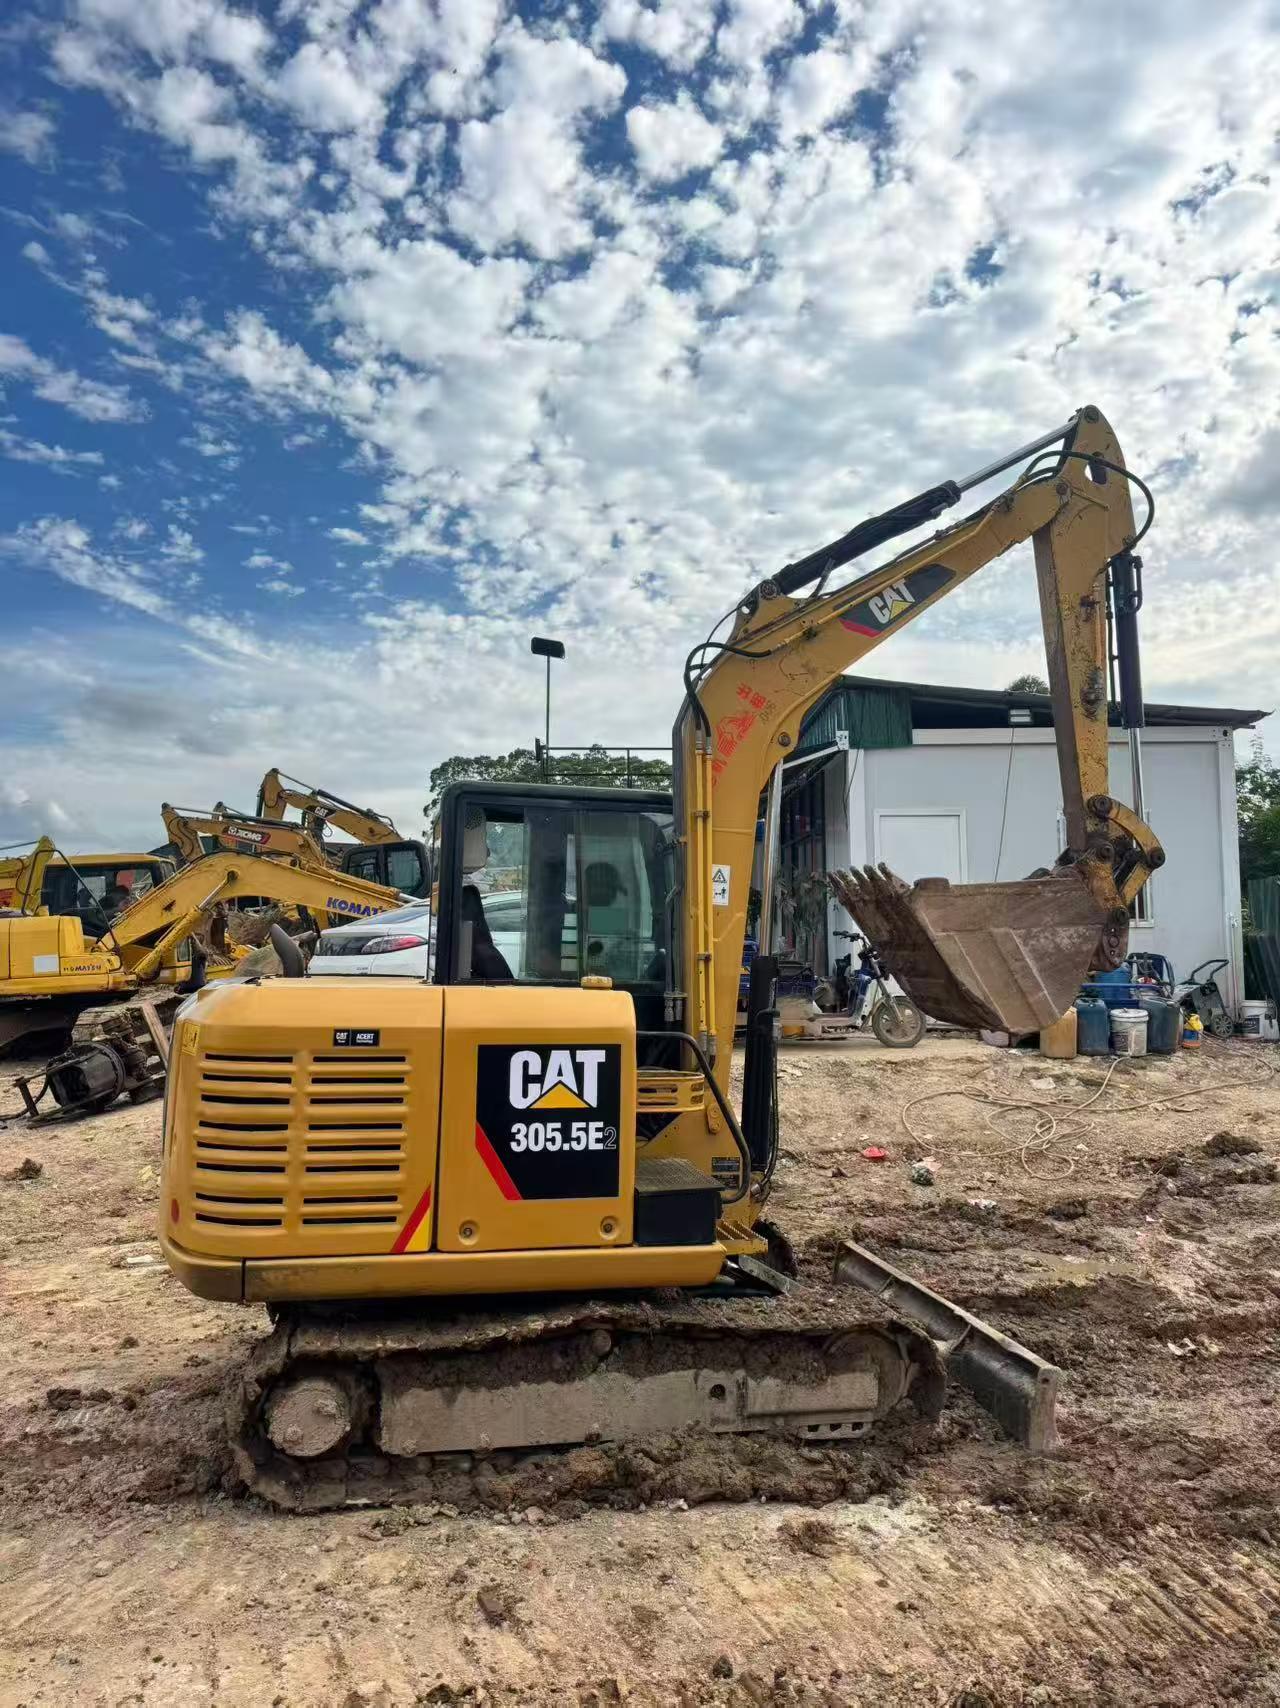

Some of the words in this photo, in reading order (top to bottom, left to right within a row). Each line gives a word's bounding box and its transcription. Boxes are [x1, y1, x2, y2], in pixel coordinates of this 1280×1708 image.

[868, 578, 915, 625] CAT
[326, 896, 387, 916] KOMAT
[335, 1032, 348, 1040] CAT
[508, 1049, 606, 1110] CAT
[510, 1121, 617, 1152] 305.5E2
